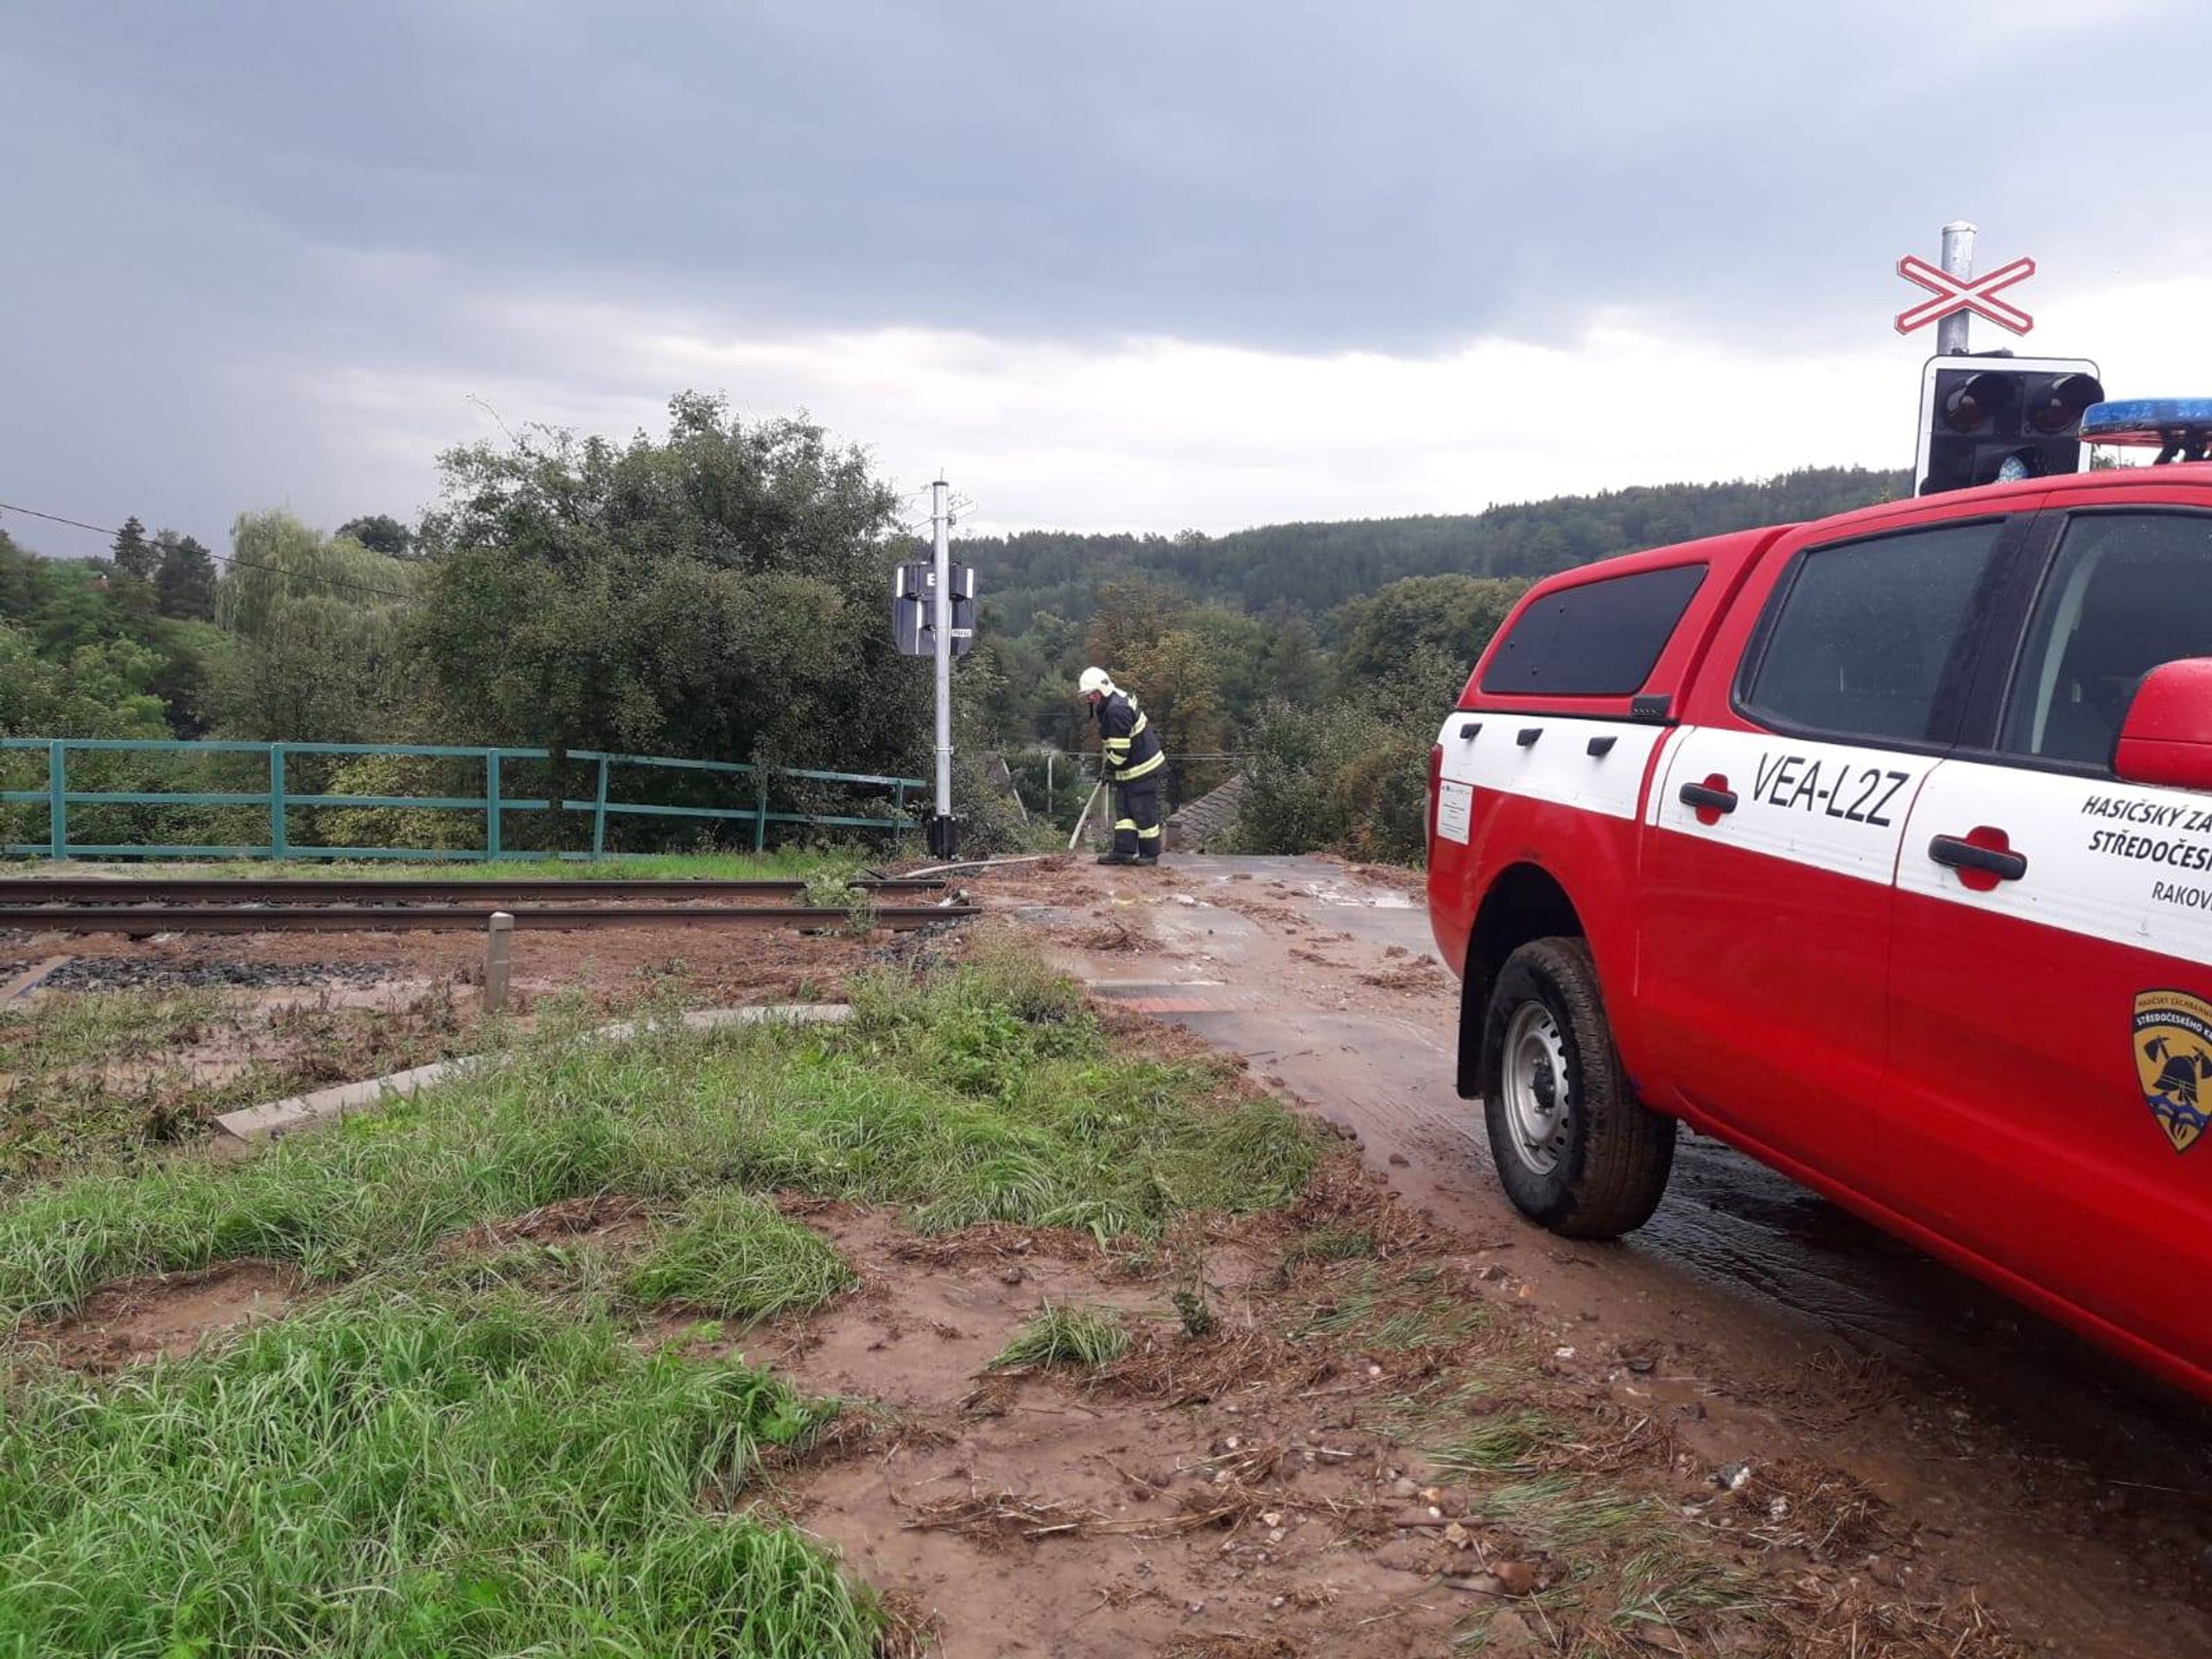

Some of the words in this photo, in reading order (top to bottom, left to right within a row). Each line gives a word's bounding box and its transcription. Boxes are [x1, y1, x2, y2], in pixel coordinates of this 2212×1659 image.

[1753, 753, 1910, 827] VEA-L2Z
[2081, 795, 2190, 827] HASIČSKÝ
[2088, 829, 2212, 872] STŘEDOČES
[2152, 880, 2212, 911] RAKOV
